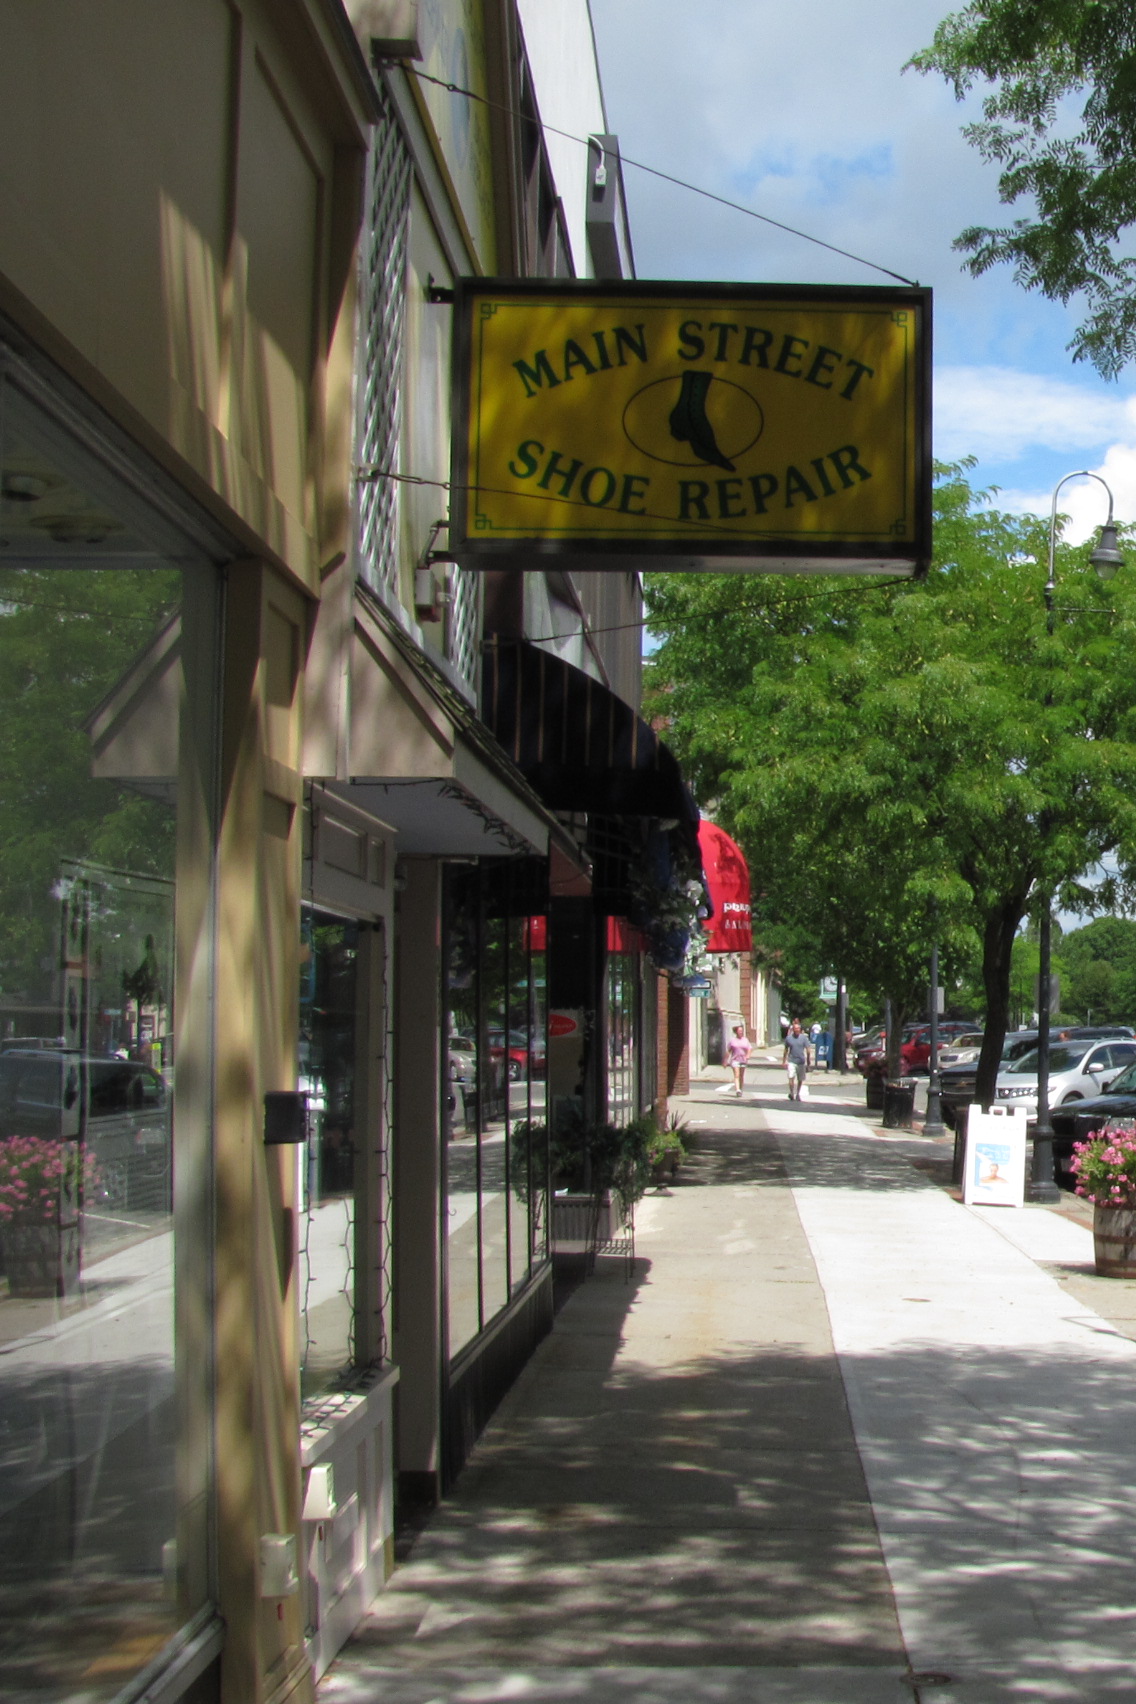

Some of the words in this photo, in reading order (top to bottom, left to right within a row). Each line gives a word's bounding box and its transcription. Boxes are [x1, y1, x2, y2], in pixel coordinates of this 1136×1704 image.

[512, 323, 649, 399] MAIN
[677, 320, 875, 401] STREET
[508, 440, 651, 517] SHOE
[677, 444, 872, 521] REPAIR
